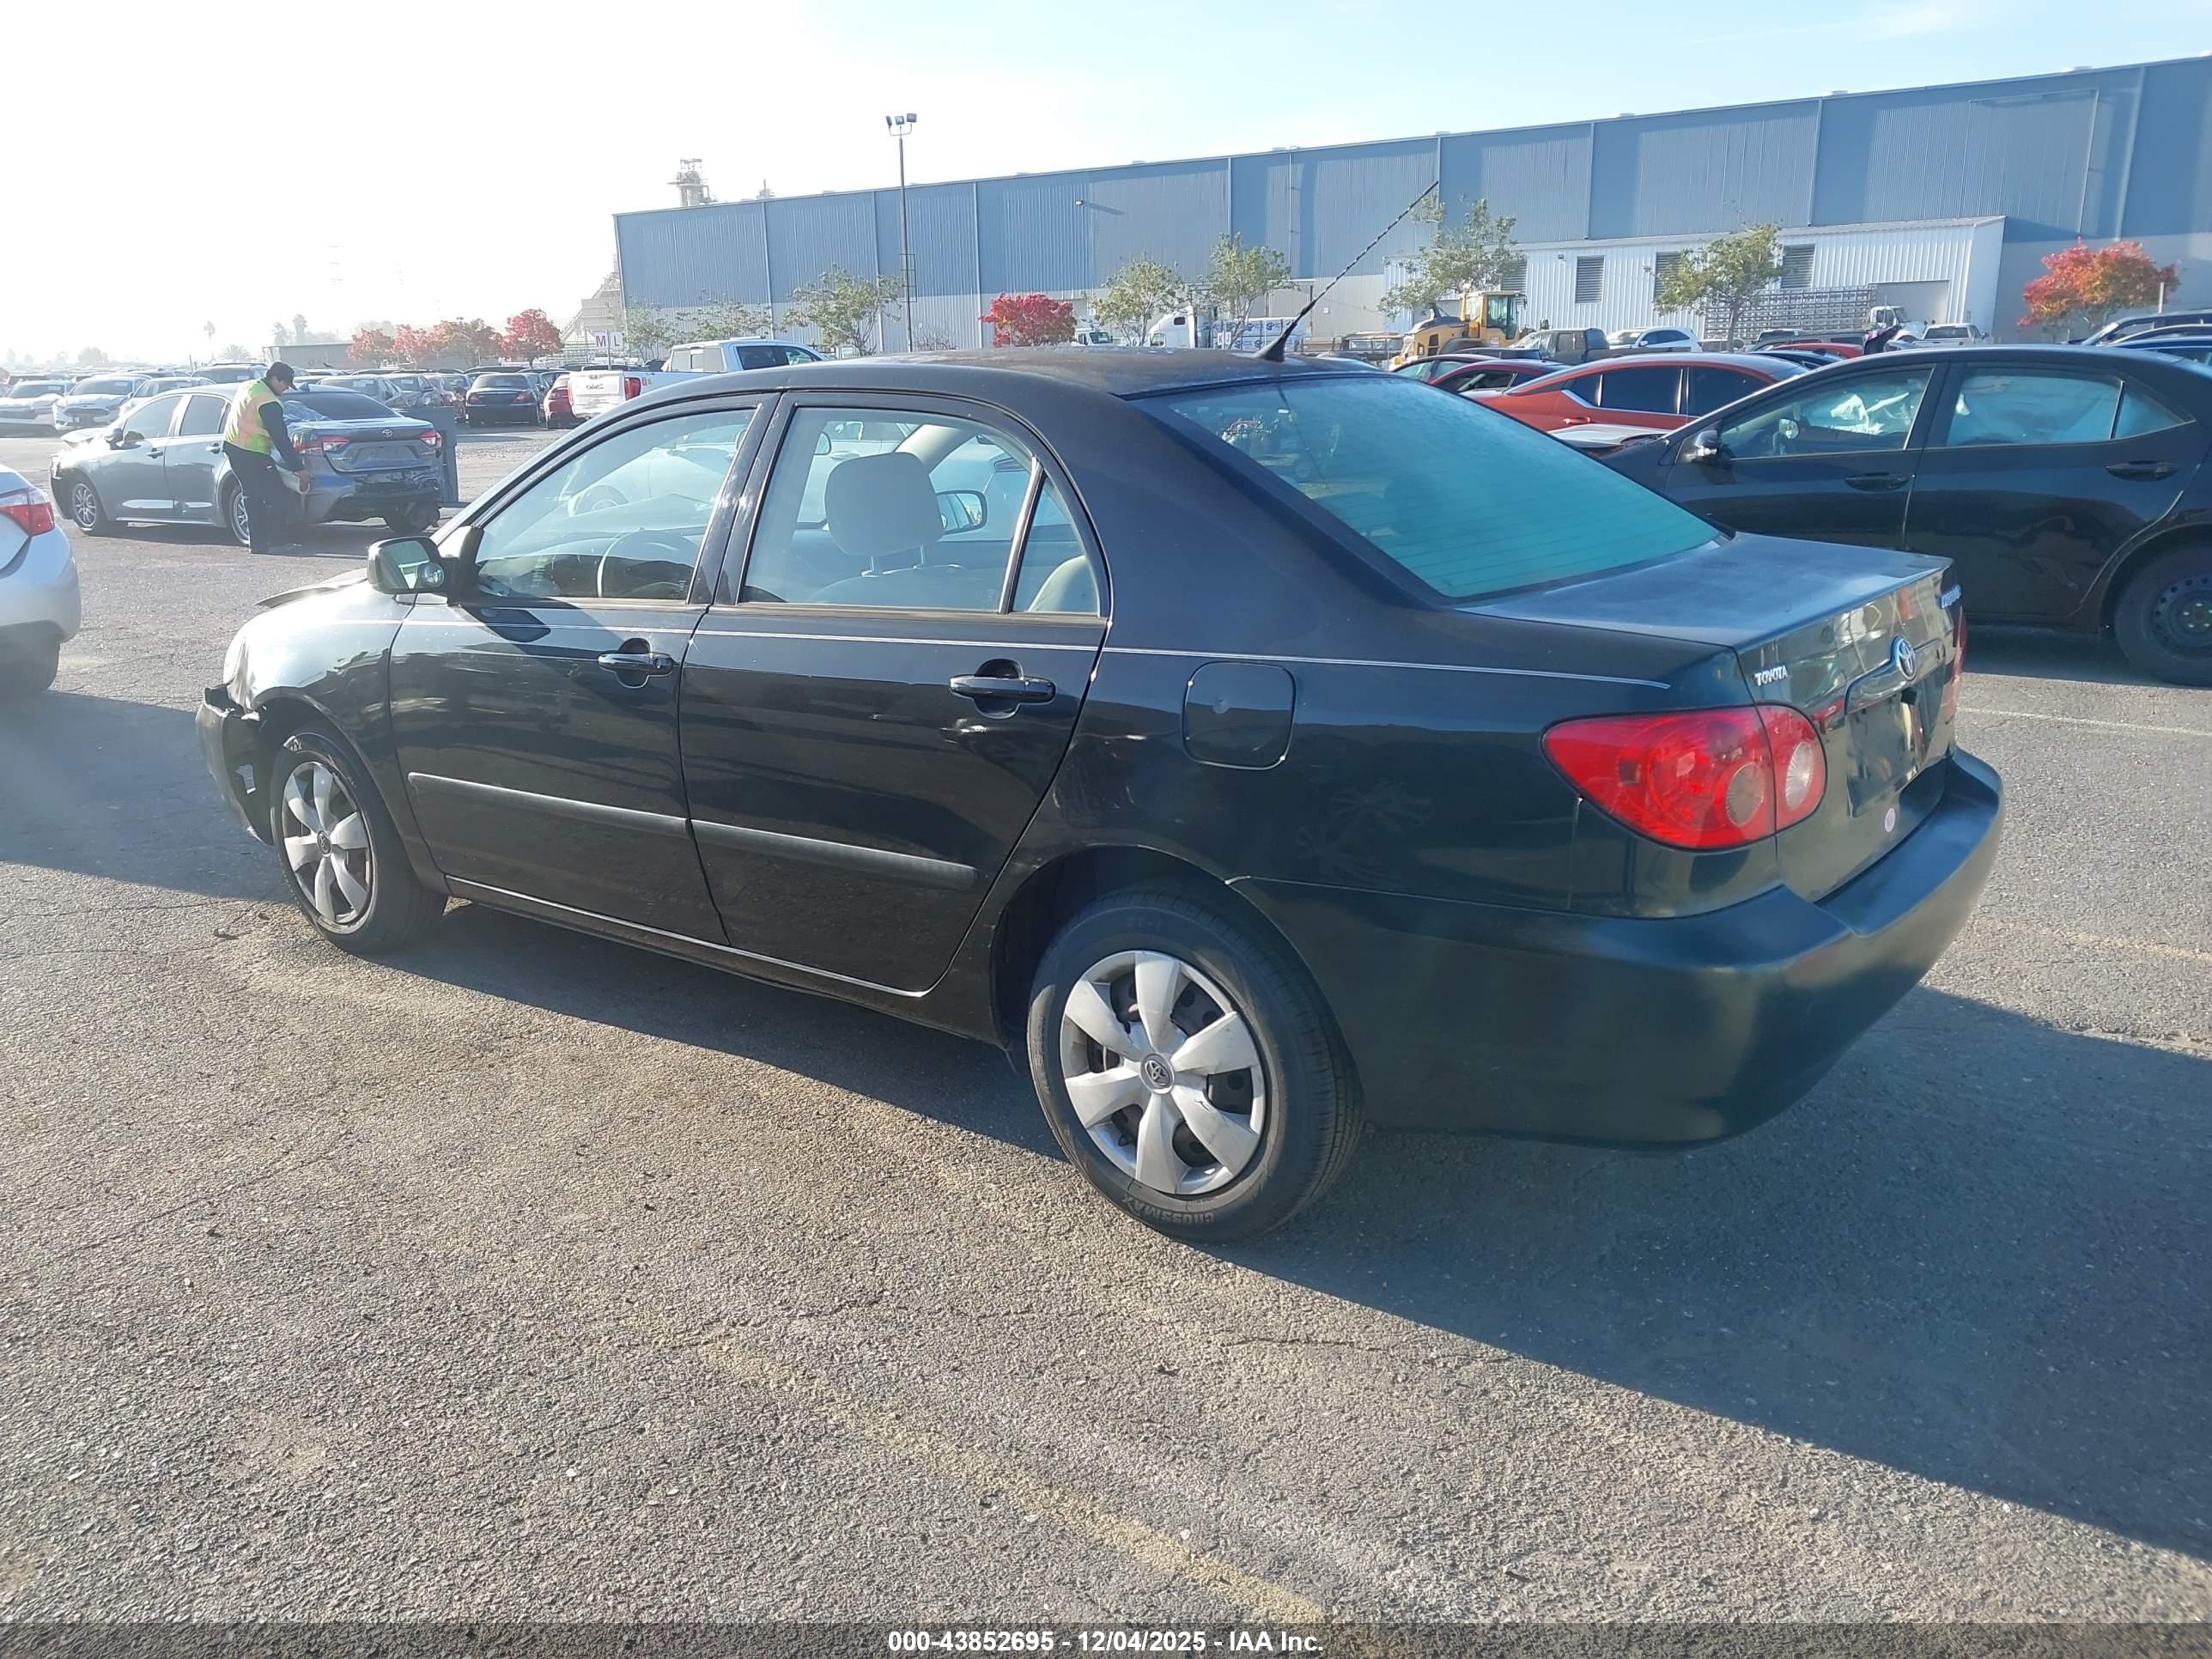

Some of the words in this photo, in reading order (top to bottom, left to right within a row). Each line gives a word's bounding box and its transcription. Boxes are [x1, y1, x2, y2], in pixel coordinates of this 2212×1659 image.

[596, 336, 606, 347] M
[613, 336, 620, 347] L
[1754, 665, 1788, 686] TOYOTA
